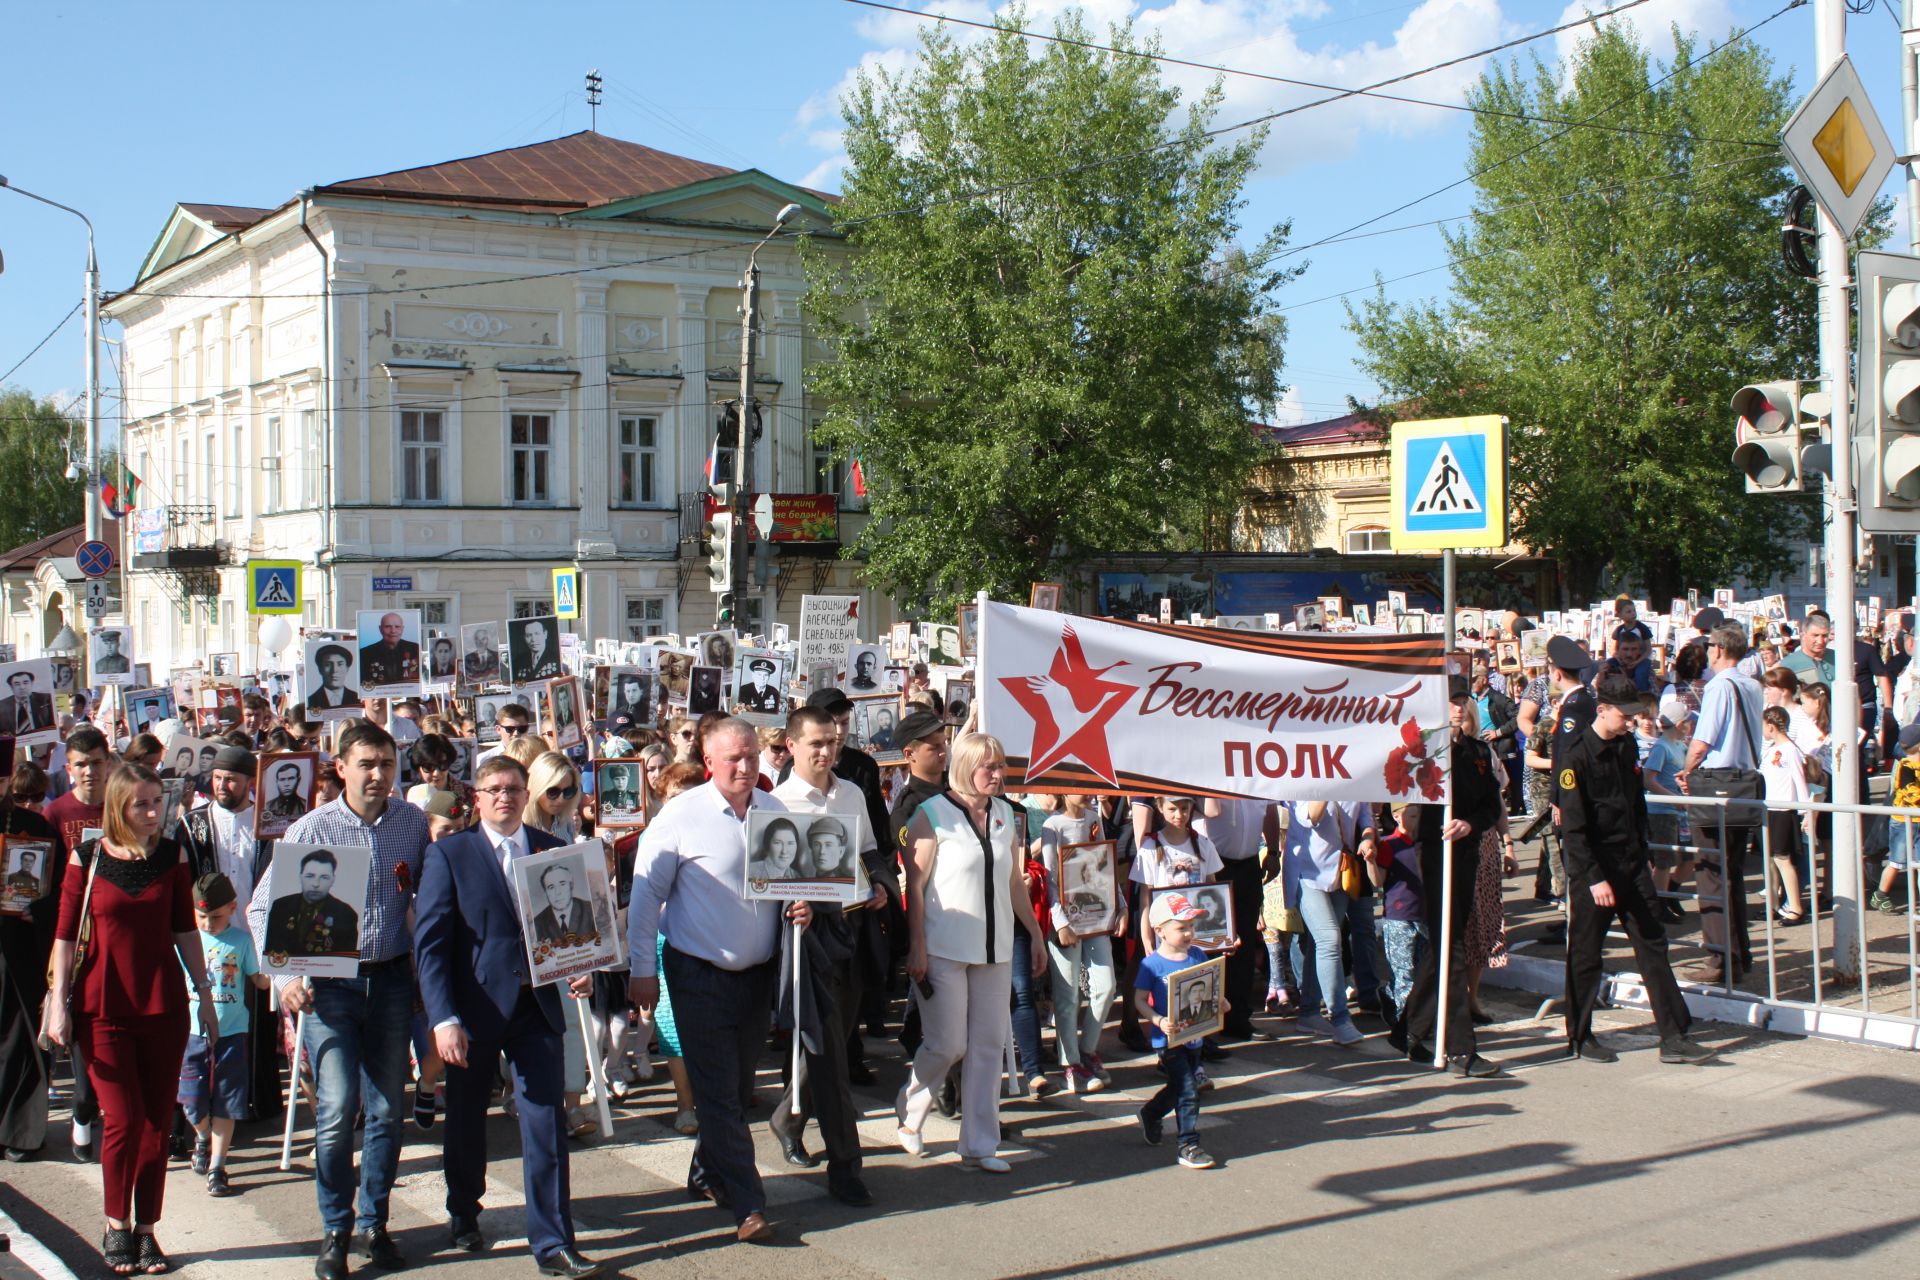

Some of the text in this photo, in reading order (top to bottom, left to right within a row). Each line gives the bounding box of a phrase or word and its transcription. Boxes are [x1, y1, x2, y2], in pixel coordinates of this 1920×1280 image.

[89, 597, 104, 607] 50
[805, 628, 855, 640] САВЕЛЬЕВИЧ
[1138, 661, 1422, 733] Бессмертный
[1223, 741, 1352, 779] ПОЛК
[539, 953, 615, 981] БЕССМЕРТНЫЙ ПОЛК
